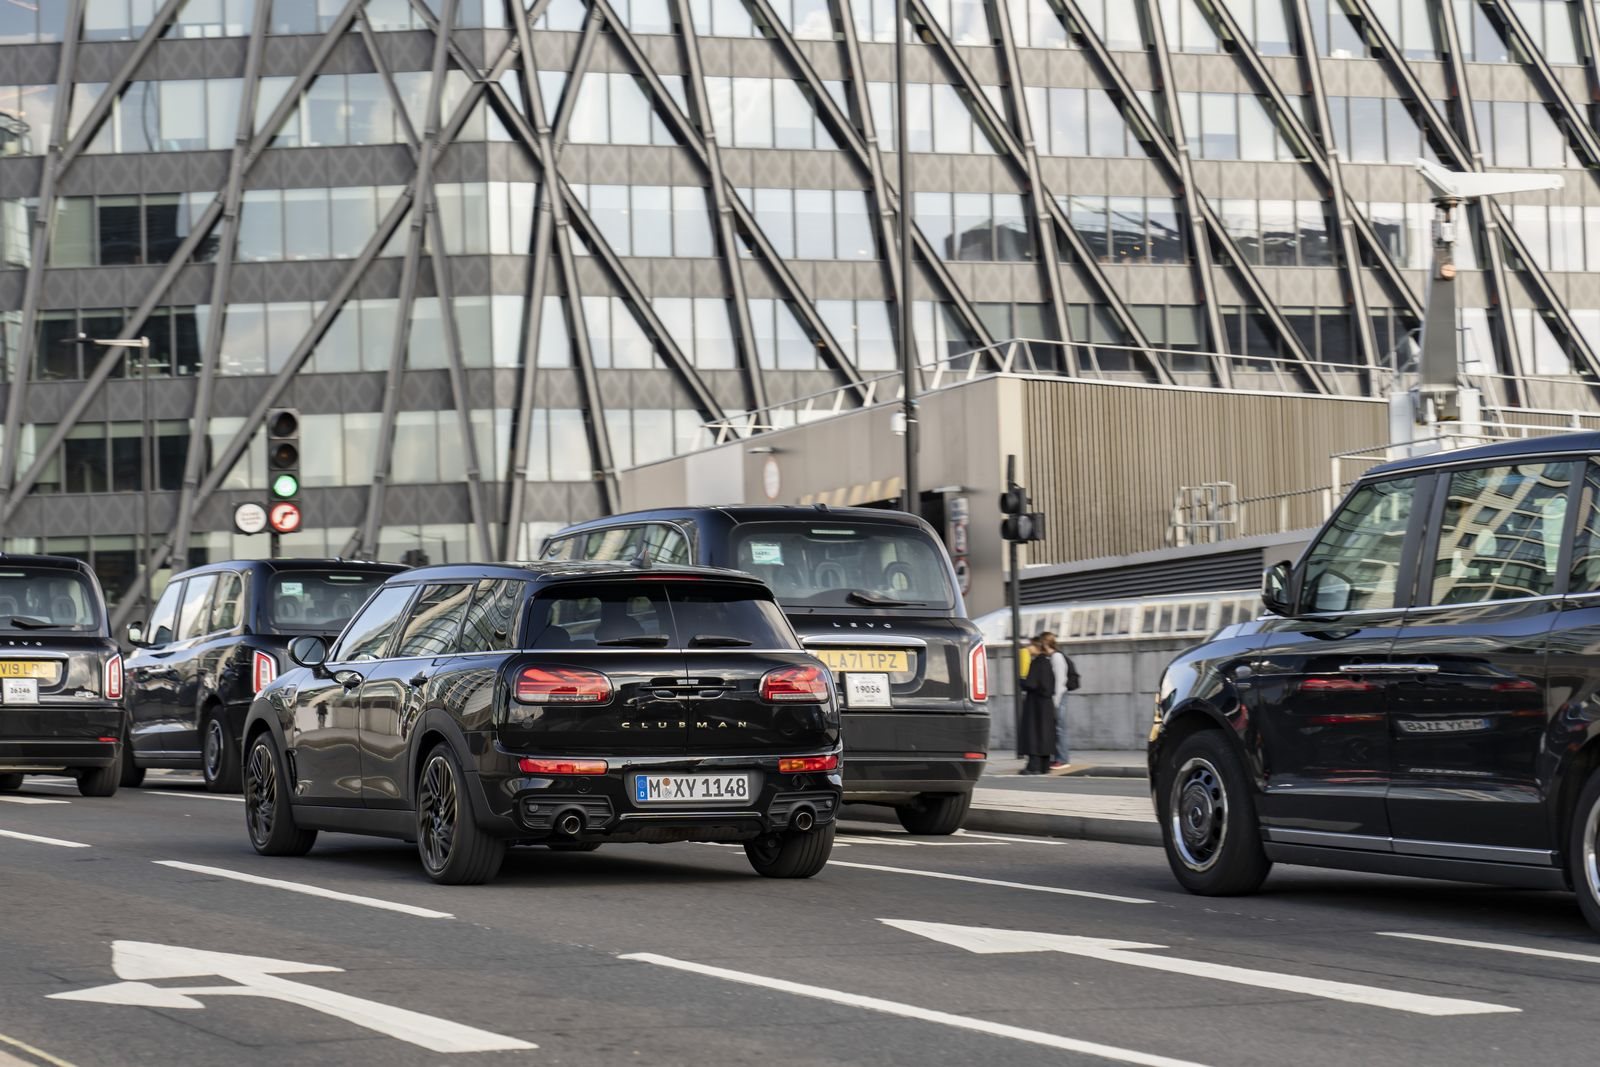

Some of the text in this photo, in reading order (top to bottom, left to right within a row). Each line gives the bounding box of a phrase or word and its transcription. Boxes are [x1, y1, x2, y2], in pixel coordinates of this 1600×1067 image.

[827, 653, 897, 669] LA71 TPZ
[855, 686, 881, 694] 19056
[621, 721, 747, 729] CLUBMAN
[649, 778, 747, 798] M XY 1148
